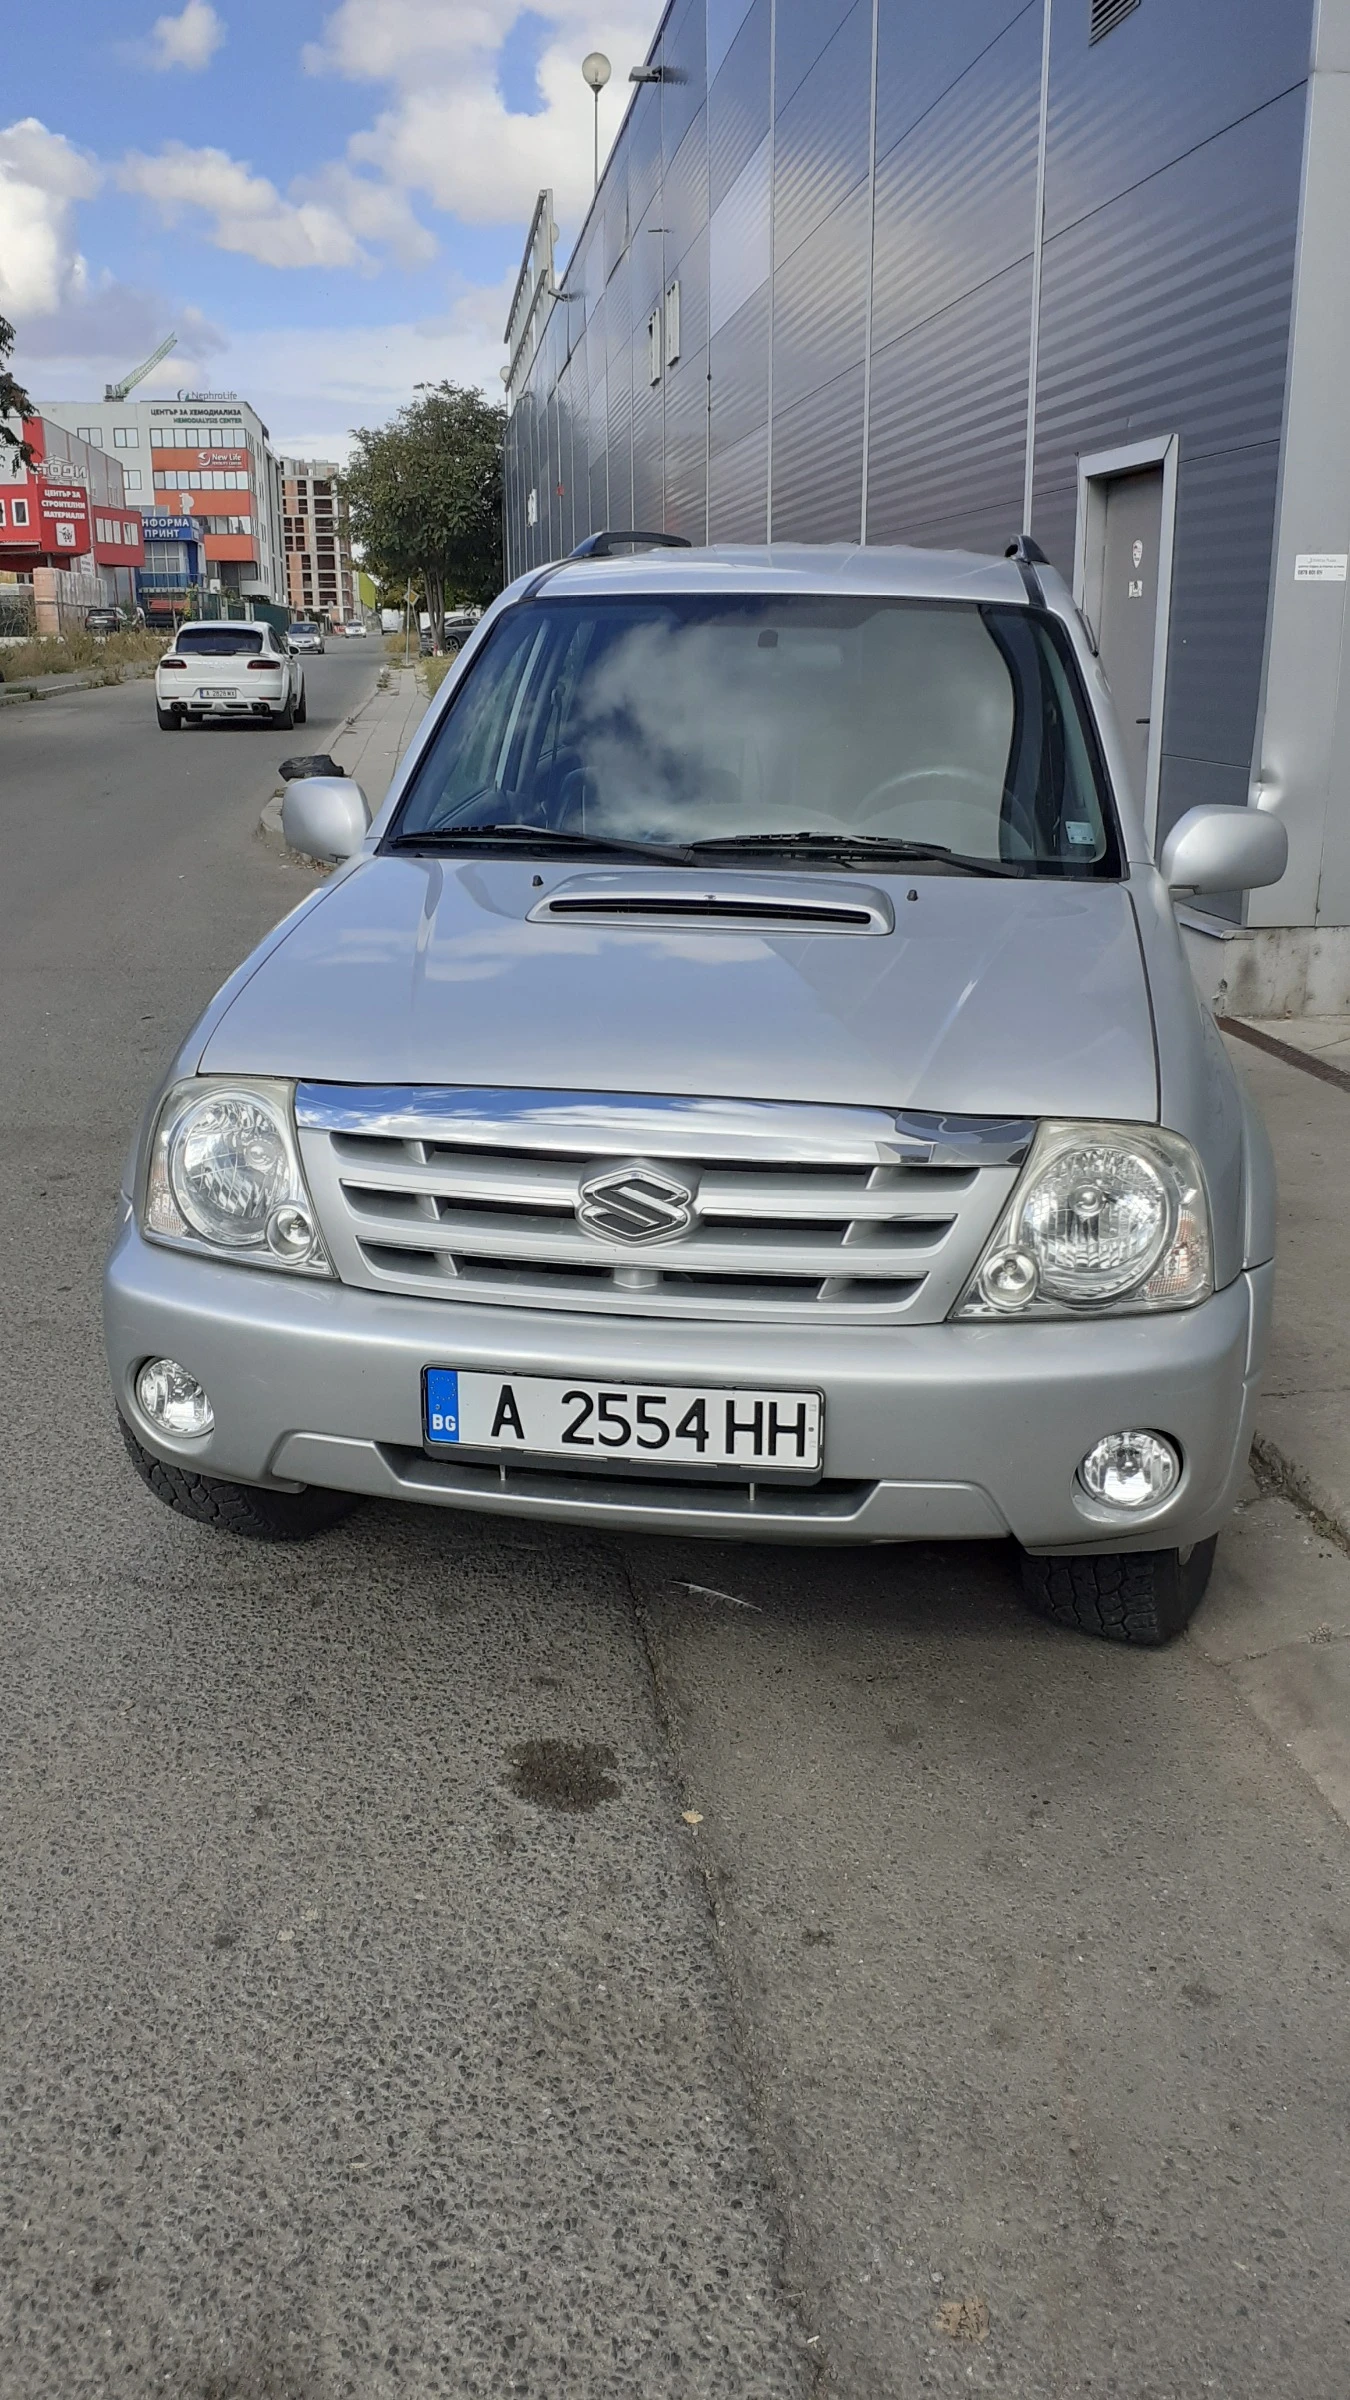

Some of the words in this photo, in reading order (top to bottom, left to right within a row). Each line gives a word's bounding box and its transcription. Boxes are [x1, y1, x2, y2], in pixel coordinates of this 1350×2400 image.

[191, 390, 238, 400] NephroLife
[212, 453, 228, 461] New
[229, 453, 242, 461] Life
[44, 489, 71, 498] ЦЕНТЪР
[41, 500, 86, 509] СТРОИТЕЛНИ
[43, 511, 86, 519] МАТЕРИАЛИ
[144, 529, 179, 538] ПРИНТ
[432, 1413, 456, 1432] BG
[490, 1384, 525, 1440] A
[561, 1389, 709, 1453] 2554
